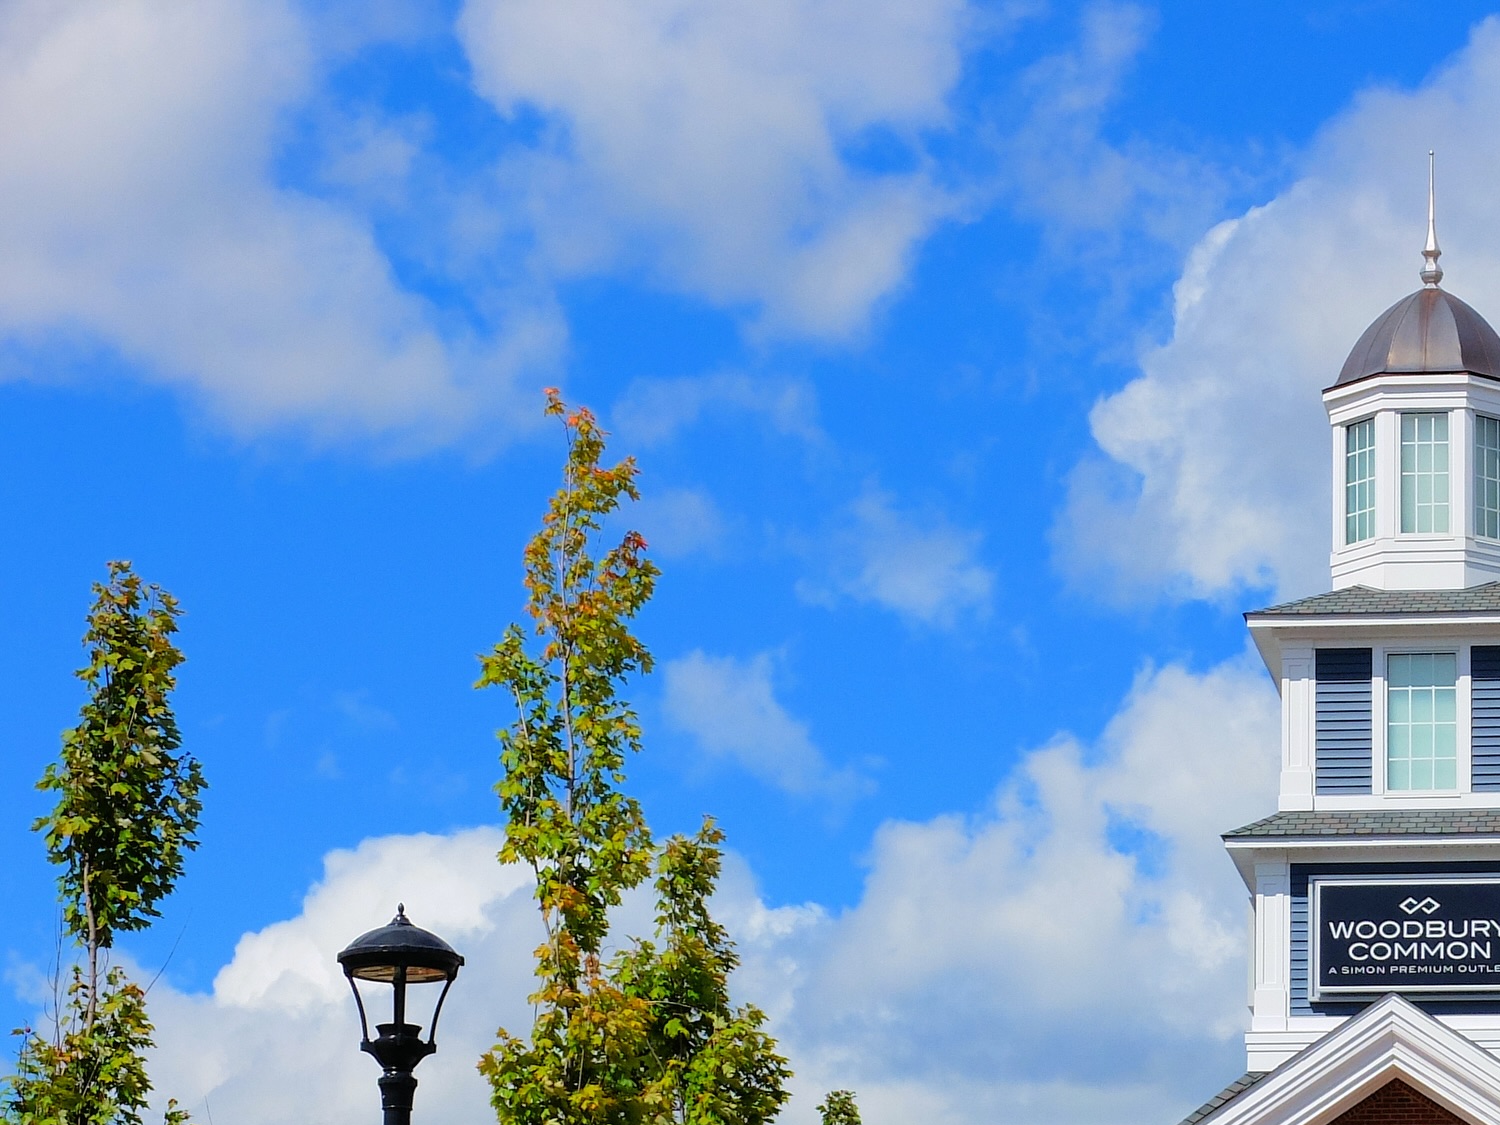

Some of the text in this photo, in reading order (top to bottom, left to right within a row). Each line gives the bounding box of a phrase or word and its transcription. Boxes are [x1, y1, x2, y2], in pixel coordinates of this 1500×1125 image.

[1348, 941, 1491, 961] COMMON
[1328, 966, 1338, 975] A
[1341, 966, 1386, 975] SIMON
[1389, 965, 1454, 974] PREMIUM
